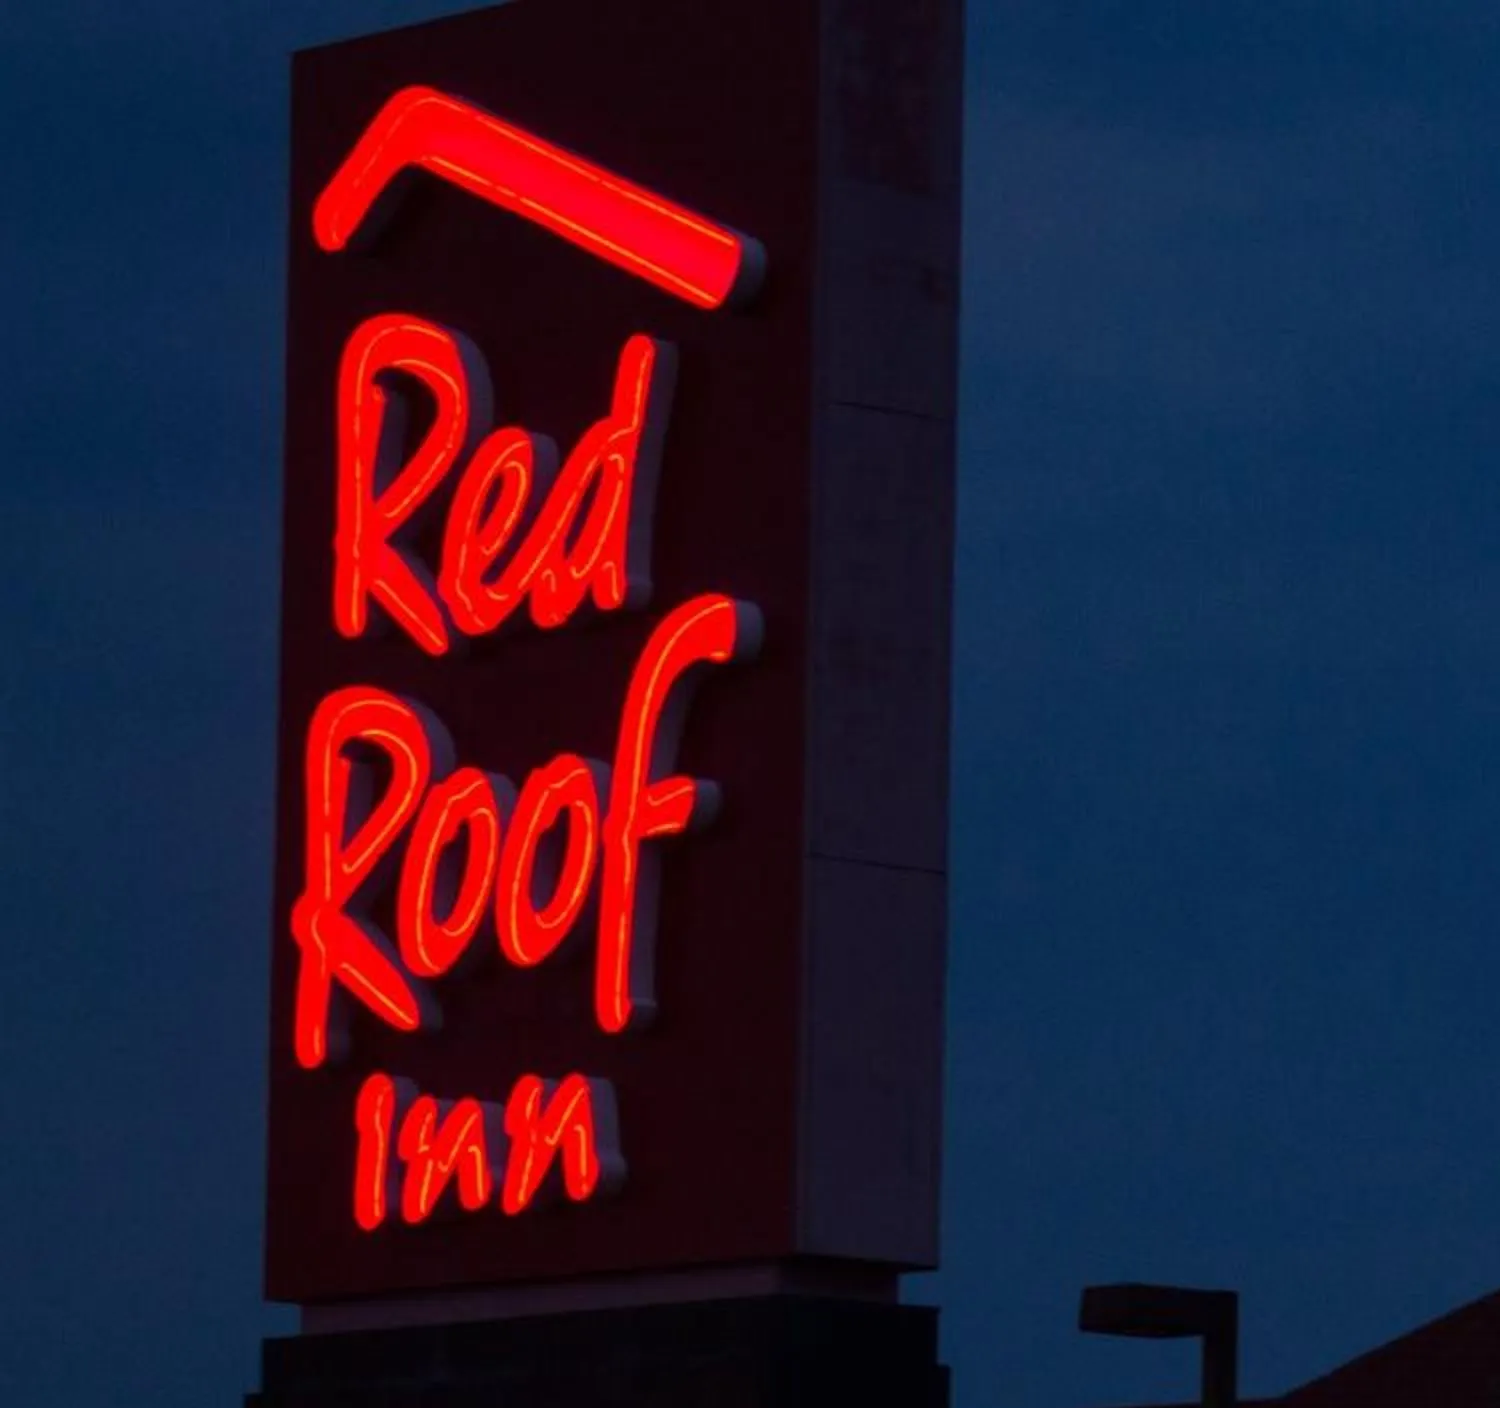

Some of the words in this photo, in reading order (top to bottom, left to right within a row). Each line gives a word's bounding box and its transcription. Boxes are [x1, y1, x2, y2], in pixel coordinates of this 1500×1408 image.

[333, 313, 656, 656] Red
[290, 593, 737, 1069] Roof
[354, 1073, 600, 1231] Inn
